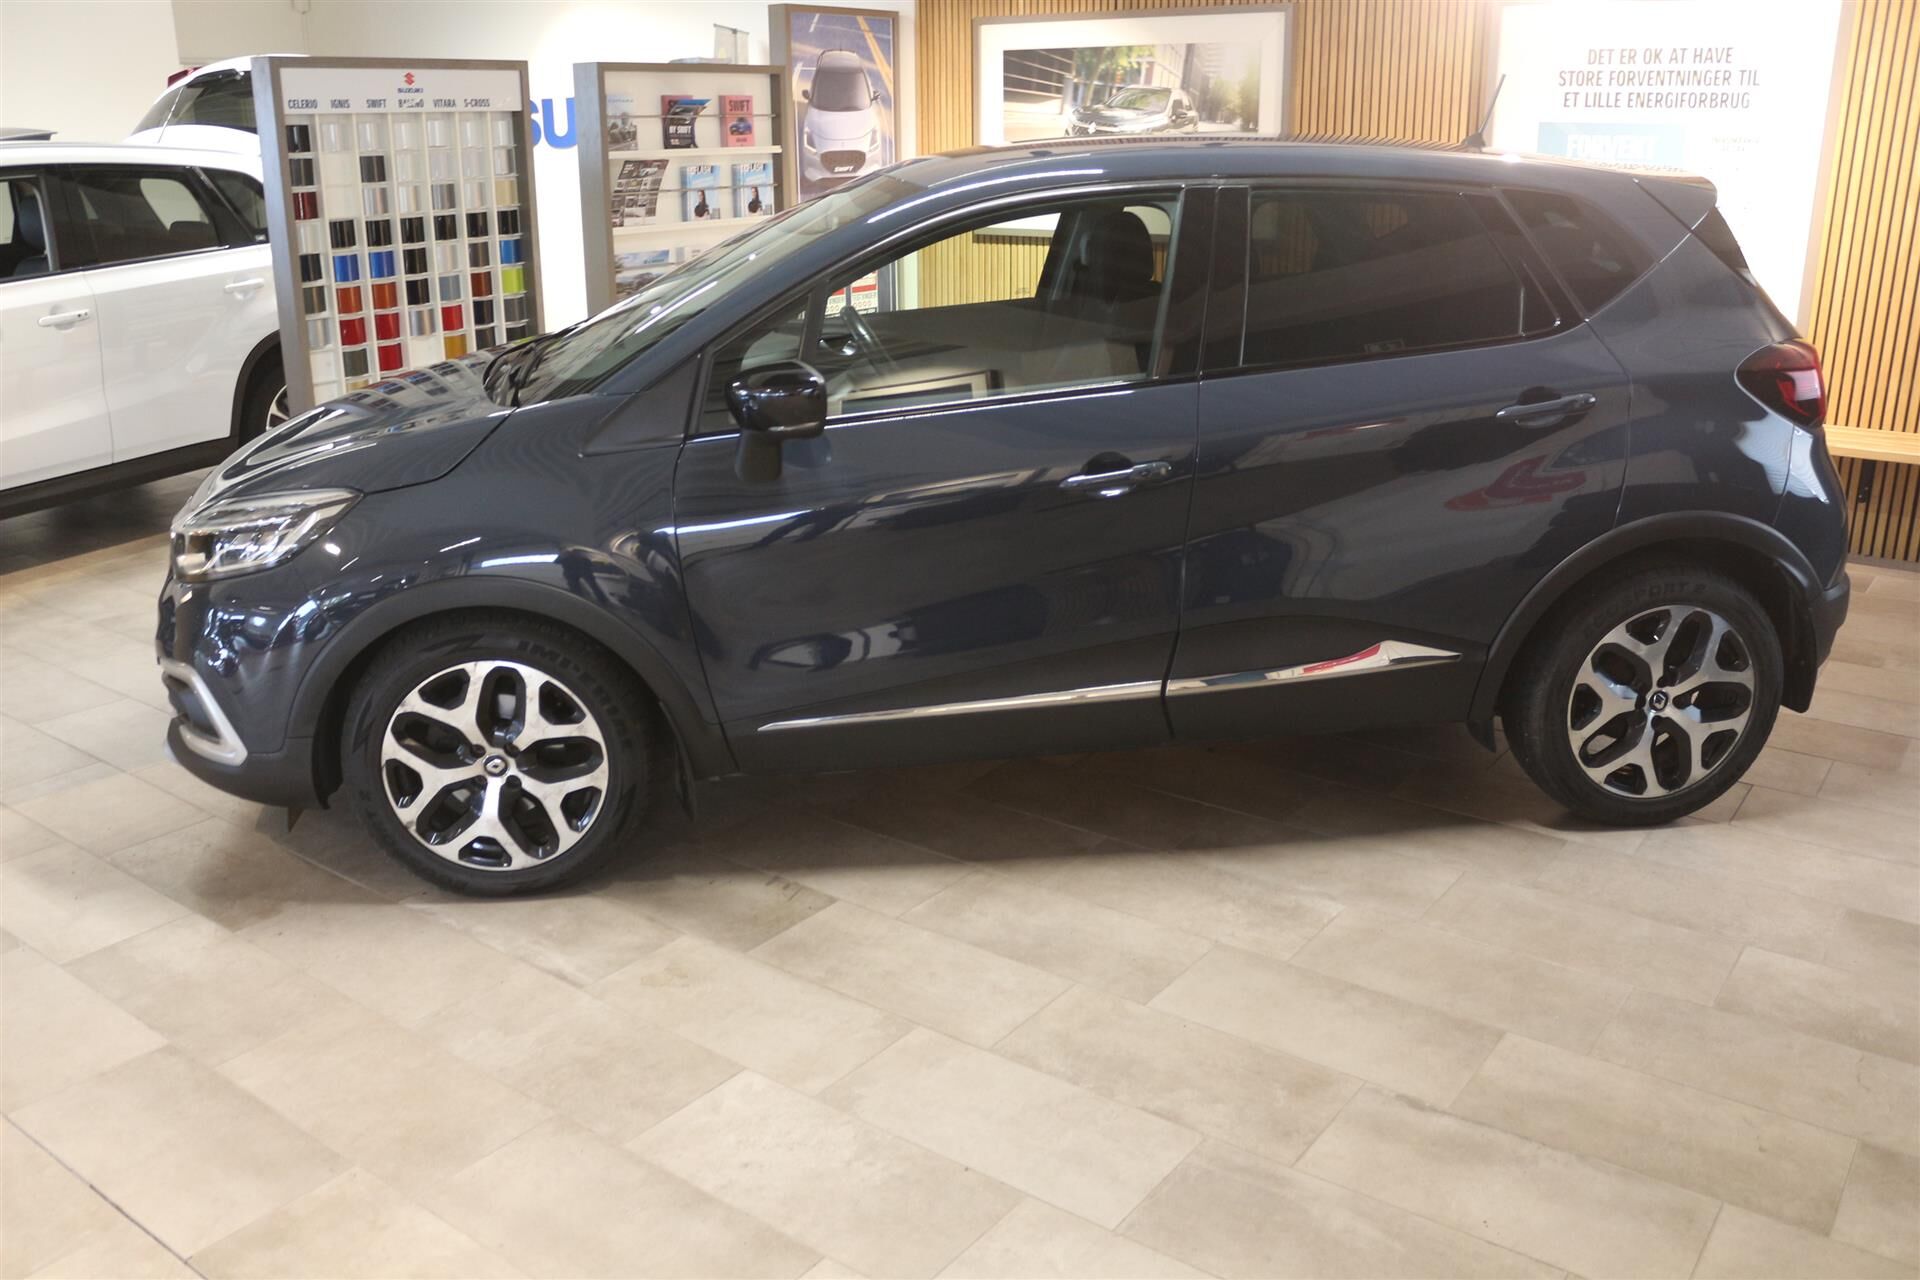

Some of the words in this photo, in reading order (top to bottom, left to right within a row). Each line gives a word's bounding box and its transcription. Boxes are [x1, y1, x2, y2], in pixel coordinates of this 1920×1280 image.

[1588, 48, 1615, 65] DET
[1619, 48, 1637, 65] ER
[1643, 48, 1663, 65] OK
[1669, 47, 1687, 64] AT
[1693, 47, 1734, 64] HAVE
[1558, 70, 1603, 87] STORE
[1608, 70, 1732, 87] FORVENTNINGER
[1740, 69, 1760, 86] TIL
[287, 98, 318, 110] CELERIO
[330, 98, 350, 109] IGNIS
[366, 98, 386, 109] SWIFT
[433, 98, 457, 108] VITARA
[463, 98, 490, 108] S-CROSS
[728, 99, 750, 112] SWIFT
[1563, 92, 1579, 108] ET
[1584, 92, 1622, 108] LILLE
[1627, 92, 1750, 108] ENERGIFORBRUG
